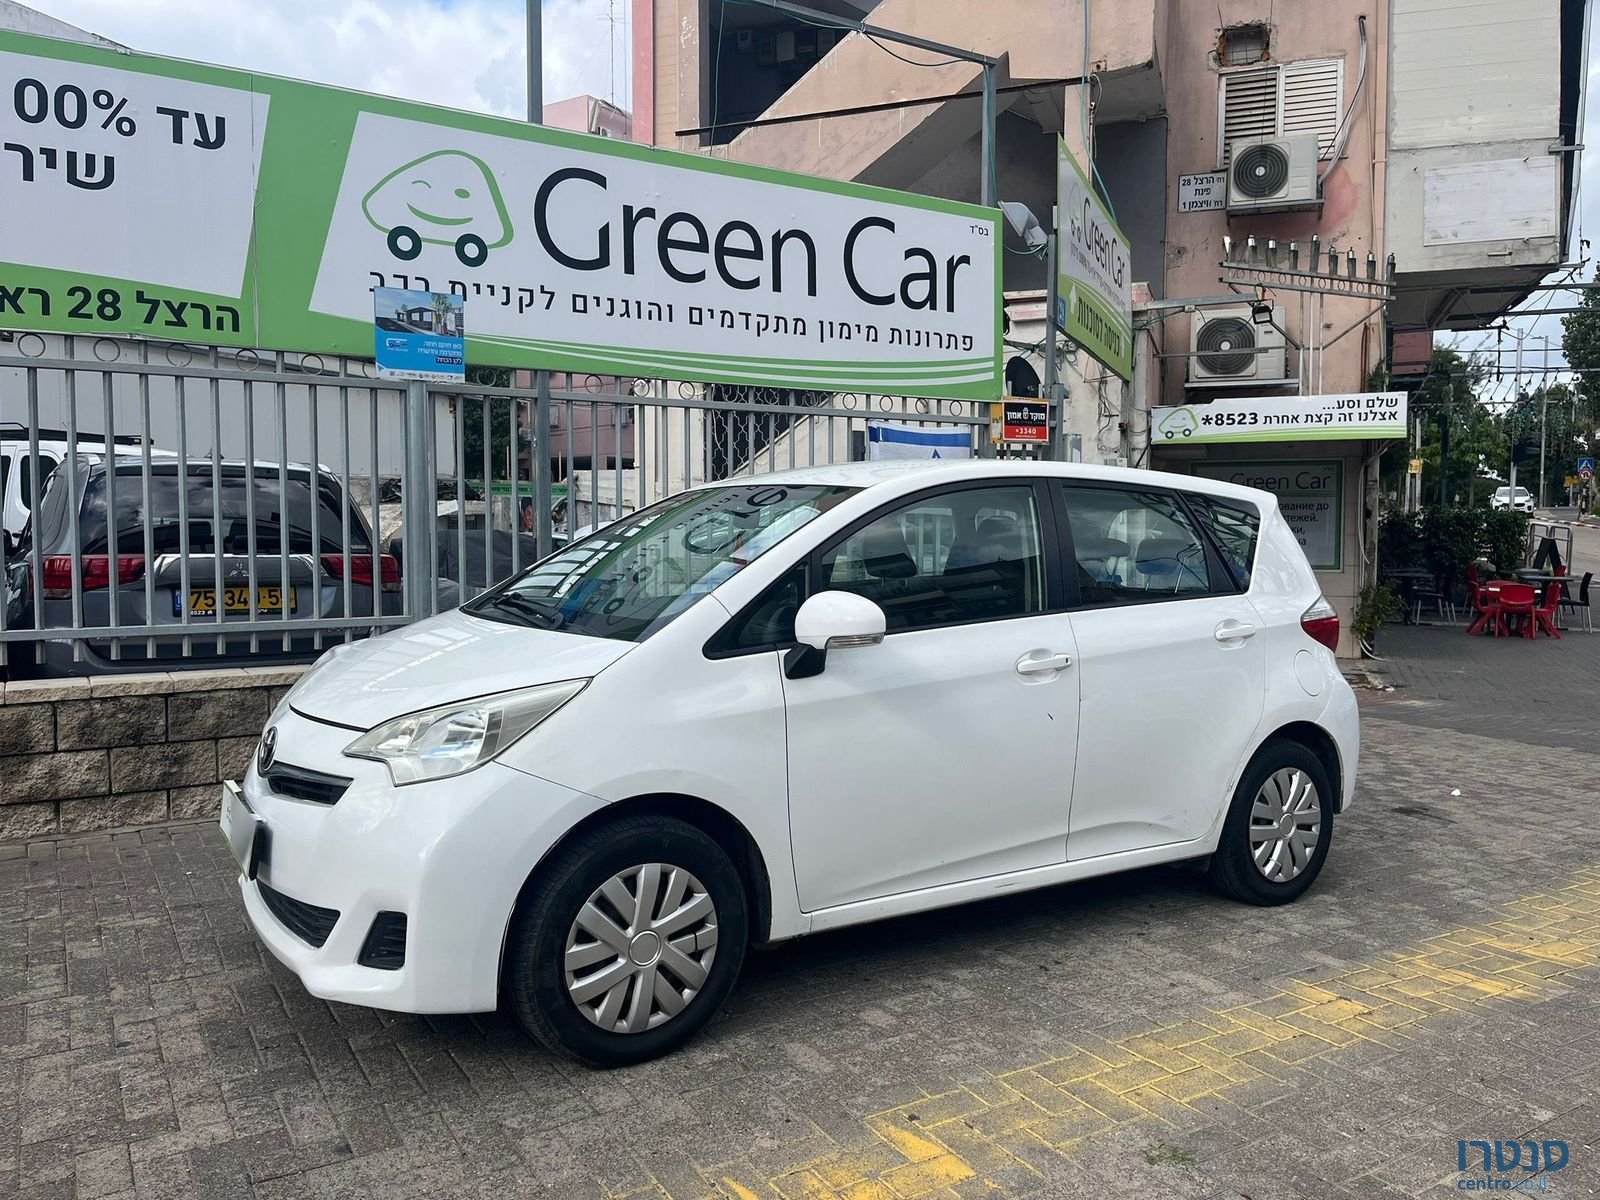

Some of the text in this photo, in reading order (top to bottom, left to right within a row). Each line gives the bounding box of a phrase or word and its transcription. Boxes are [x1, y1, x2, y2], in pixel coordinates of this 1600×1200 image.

[156, 105, 226, 150] עד
[3, 142, 115, 190] שיר
[1182, 178, 1191, 186] 28
[1193, 176, 1214, 185] הרצל
[1194, 187, 1211, 196] פינת
[969, 224, 989, 236] בס"ד
[533, 167, 818, 298] Green
[843, 216, 971, 313] Car
[1083, 196, 1111, 276] Green
[1111, 237, 1125, 291] Car
[66, 285, 122, 321] 28
[448, 279, 556, 314] לקניית
[135, 290, 240, 332] הרצל
[571, 293, 673, 323] והוגנים
[688, 306, 807, 337] מתקדמים
[818, 320, 879, 343] מימון
[888, 327, 974, 351] פתרונות
[1366, 396, 1399, 408] שלם
[1007, 411, 1045, 422] מוקד אמון
[1263, 414, 1300, 425] אחרת
[1303, 413, 1334, 425] קצת
[1338, 412, 1354, 422] זה
[1358, 409, 1398, 422] אצלנו
[1230, 471, 1331, 490] Green Car
[1315, 502, 1330, 512] до
[1283, 512, 1319, 522] тежей.
